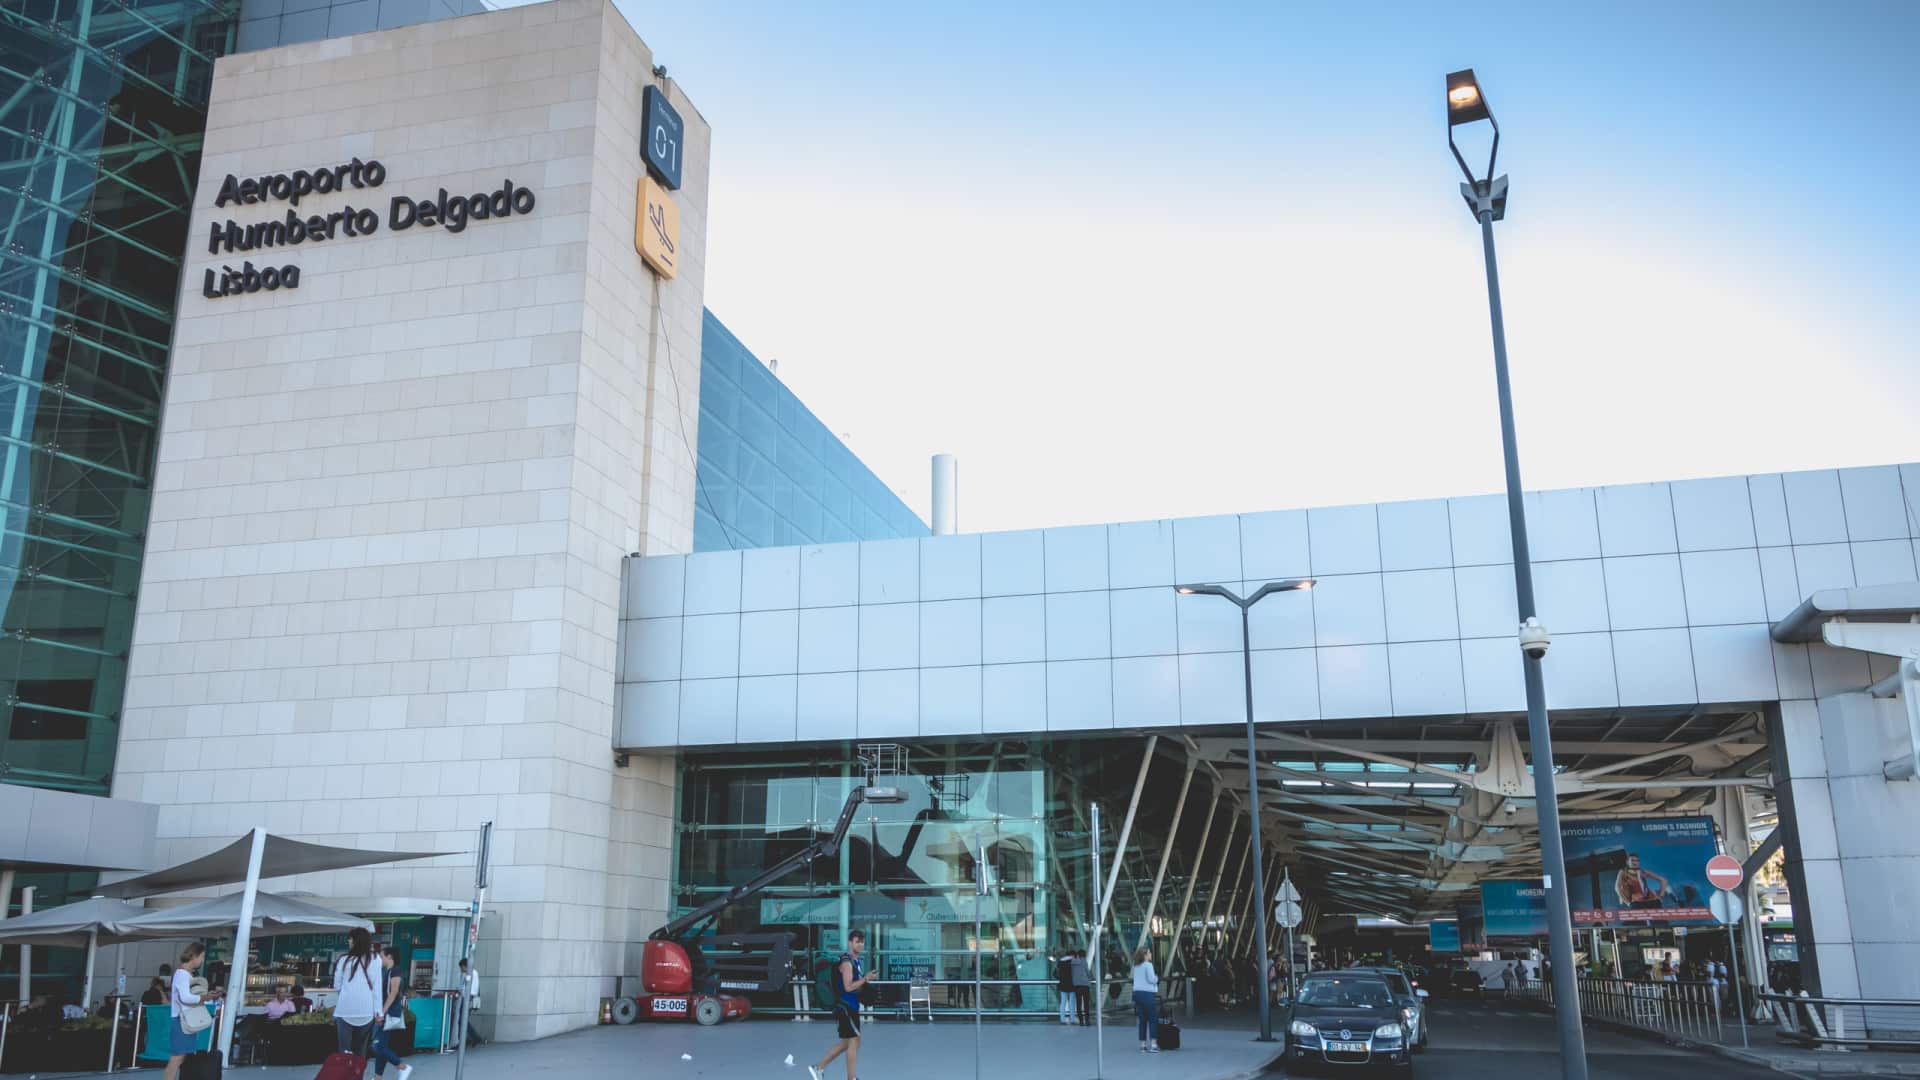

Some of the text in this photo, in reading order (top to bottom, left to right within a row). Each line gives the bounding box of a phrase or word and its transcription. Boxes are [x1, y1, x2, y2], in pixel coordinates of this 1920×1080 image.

[655, 124, 676, 172] 01
[215, 157, 386, 208] Aeroporto
[208, 179, 535, 255] Humberto Delgado
[203, 261, 300, 299] Lisboa
